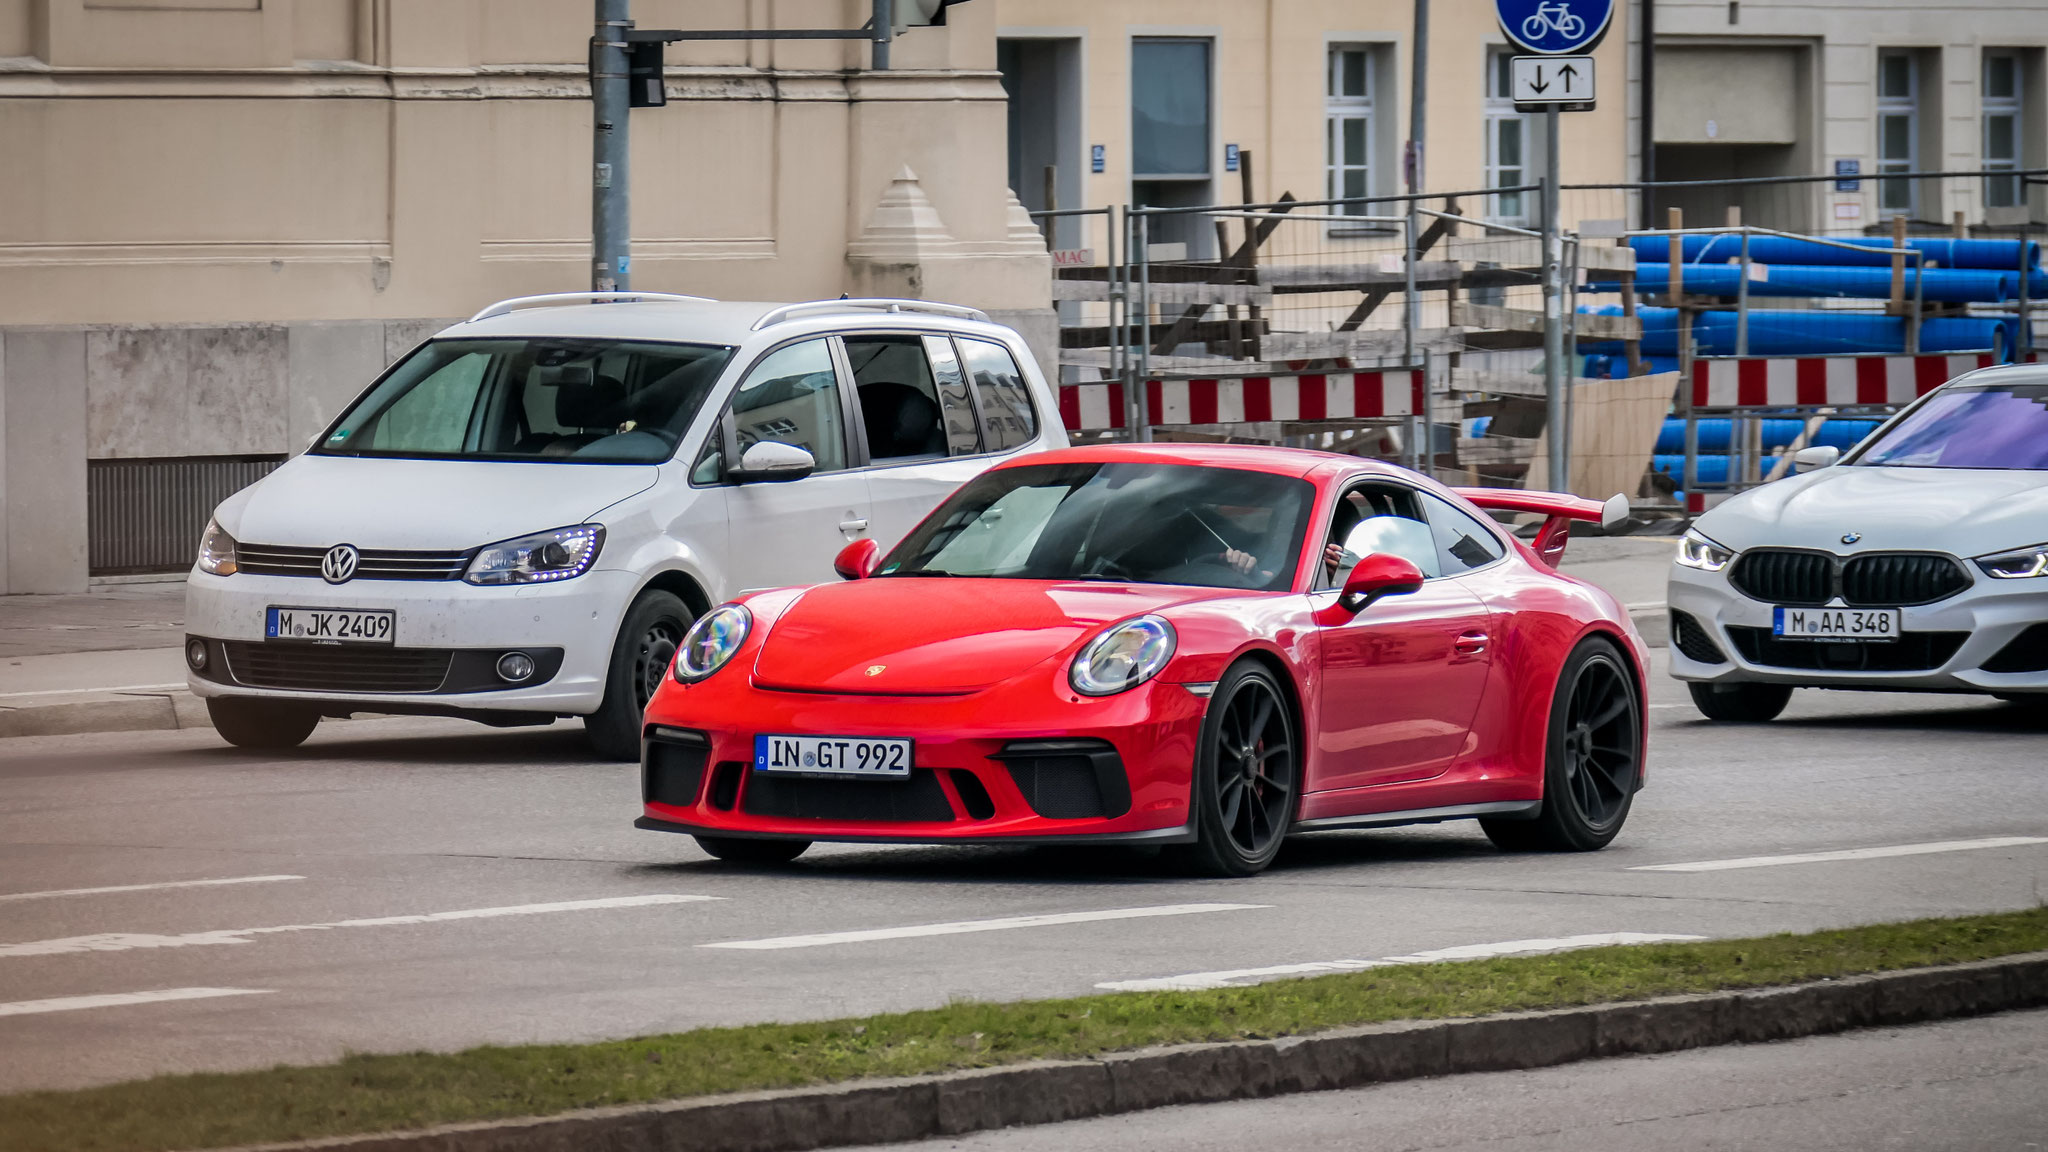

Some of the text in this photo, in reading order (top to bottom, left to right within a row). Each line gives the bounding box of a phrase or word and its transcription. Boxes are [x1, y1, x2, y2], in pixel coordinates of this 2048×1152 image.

[280, 612, 390, 638] M JK 2409
[1792, 611, 1890, 633] M AA 348
[771, 740, 904, 771] IN GT 992
